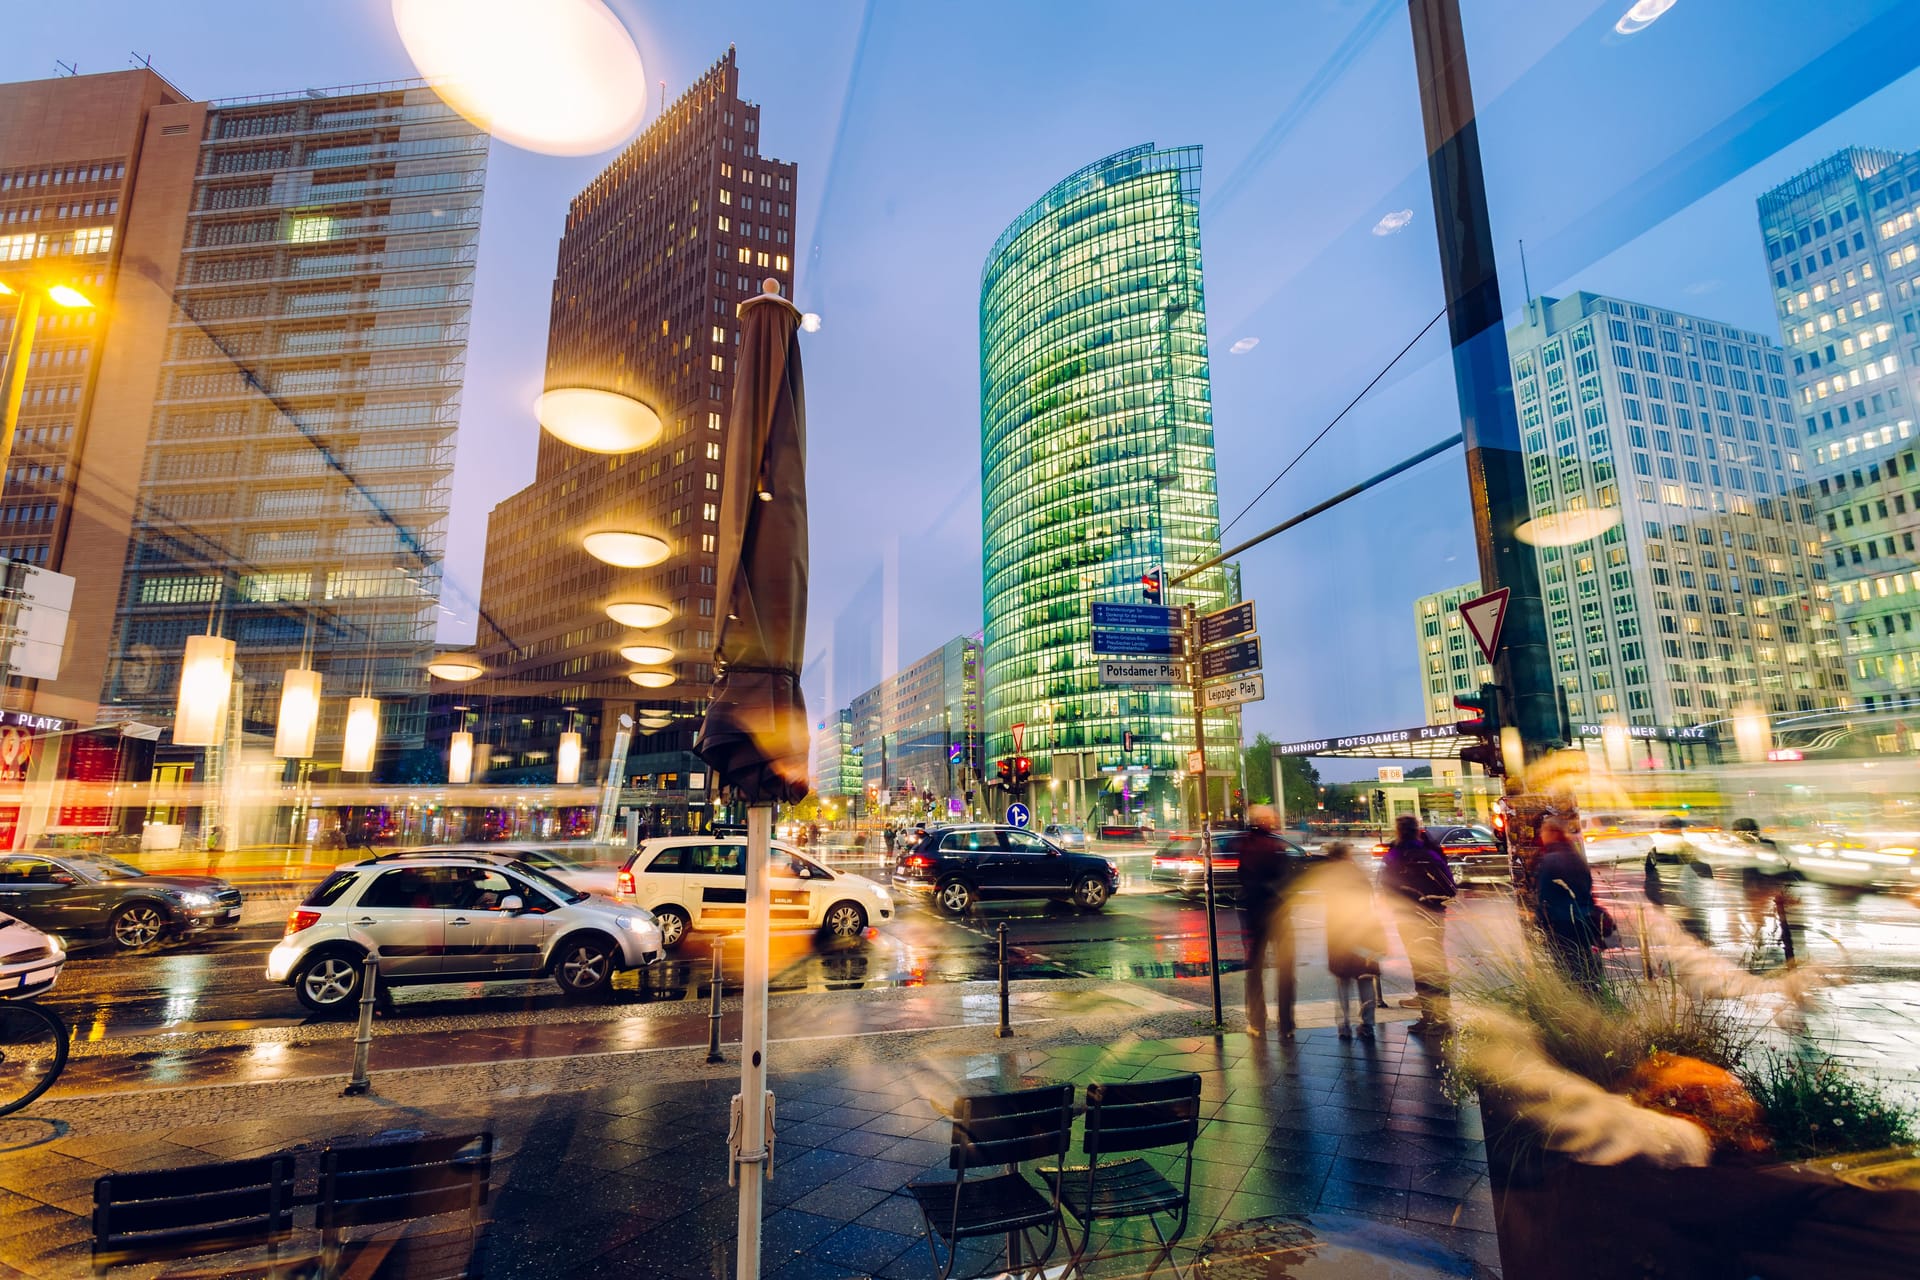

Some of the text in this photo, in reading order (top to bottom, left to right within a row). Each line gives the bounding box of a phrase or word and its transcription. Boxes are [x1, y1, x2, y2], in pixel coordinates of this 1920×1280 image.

[1106, 664, 1182, 680] Potsdamer Platz
[1208, 682, 1257, 702] Leipziger Platz
[18, 714, 62, 731] PLATZ
[1281, 725, 1460, 754] BAHNHOF POTSDAMER PLAT
